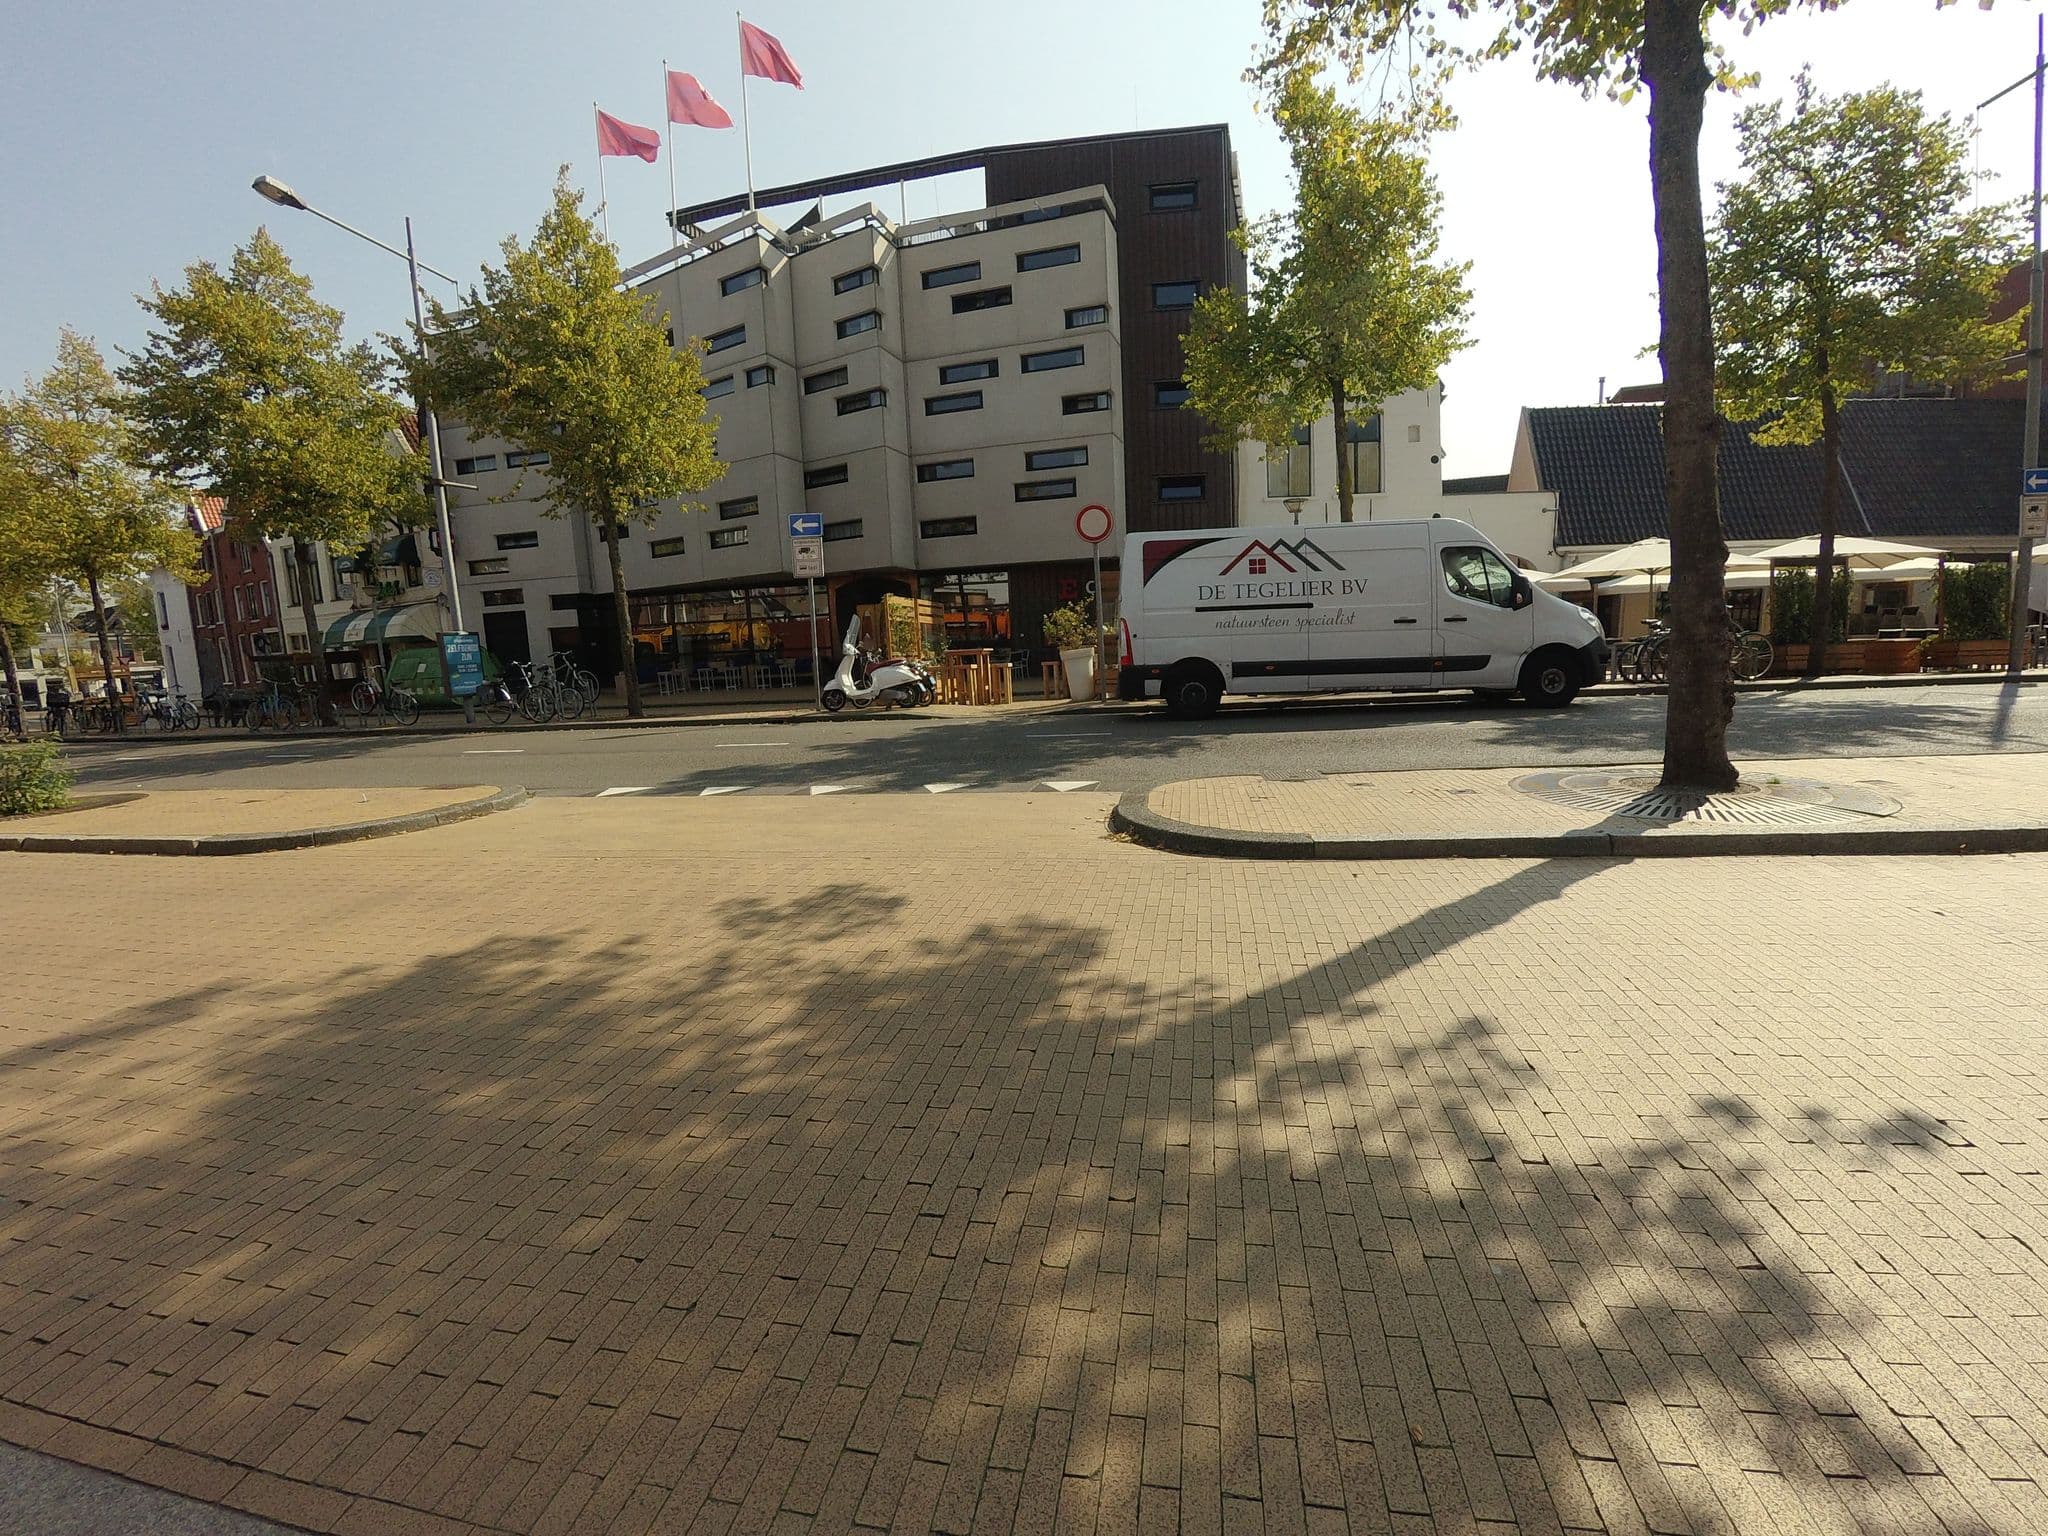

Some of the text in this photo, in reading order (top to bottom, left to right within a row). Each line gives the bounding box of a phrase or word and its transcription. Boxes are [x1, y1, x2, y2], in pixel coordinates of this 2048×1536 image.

[1198, 578, 1369, 601] DE TEGELIER BV
[1215, 607, 1356, 632] natuursteen specialist
